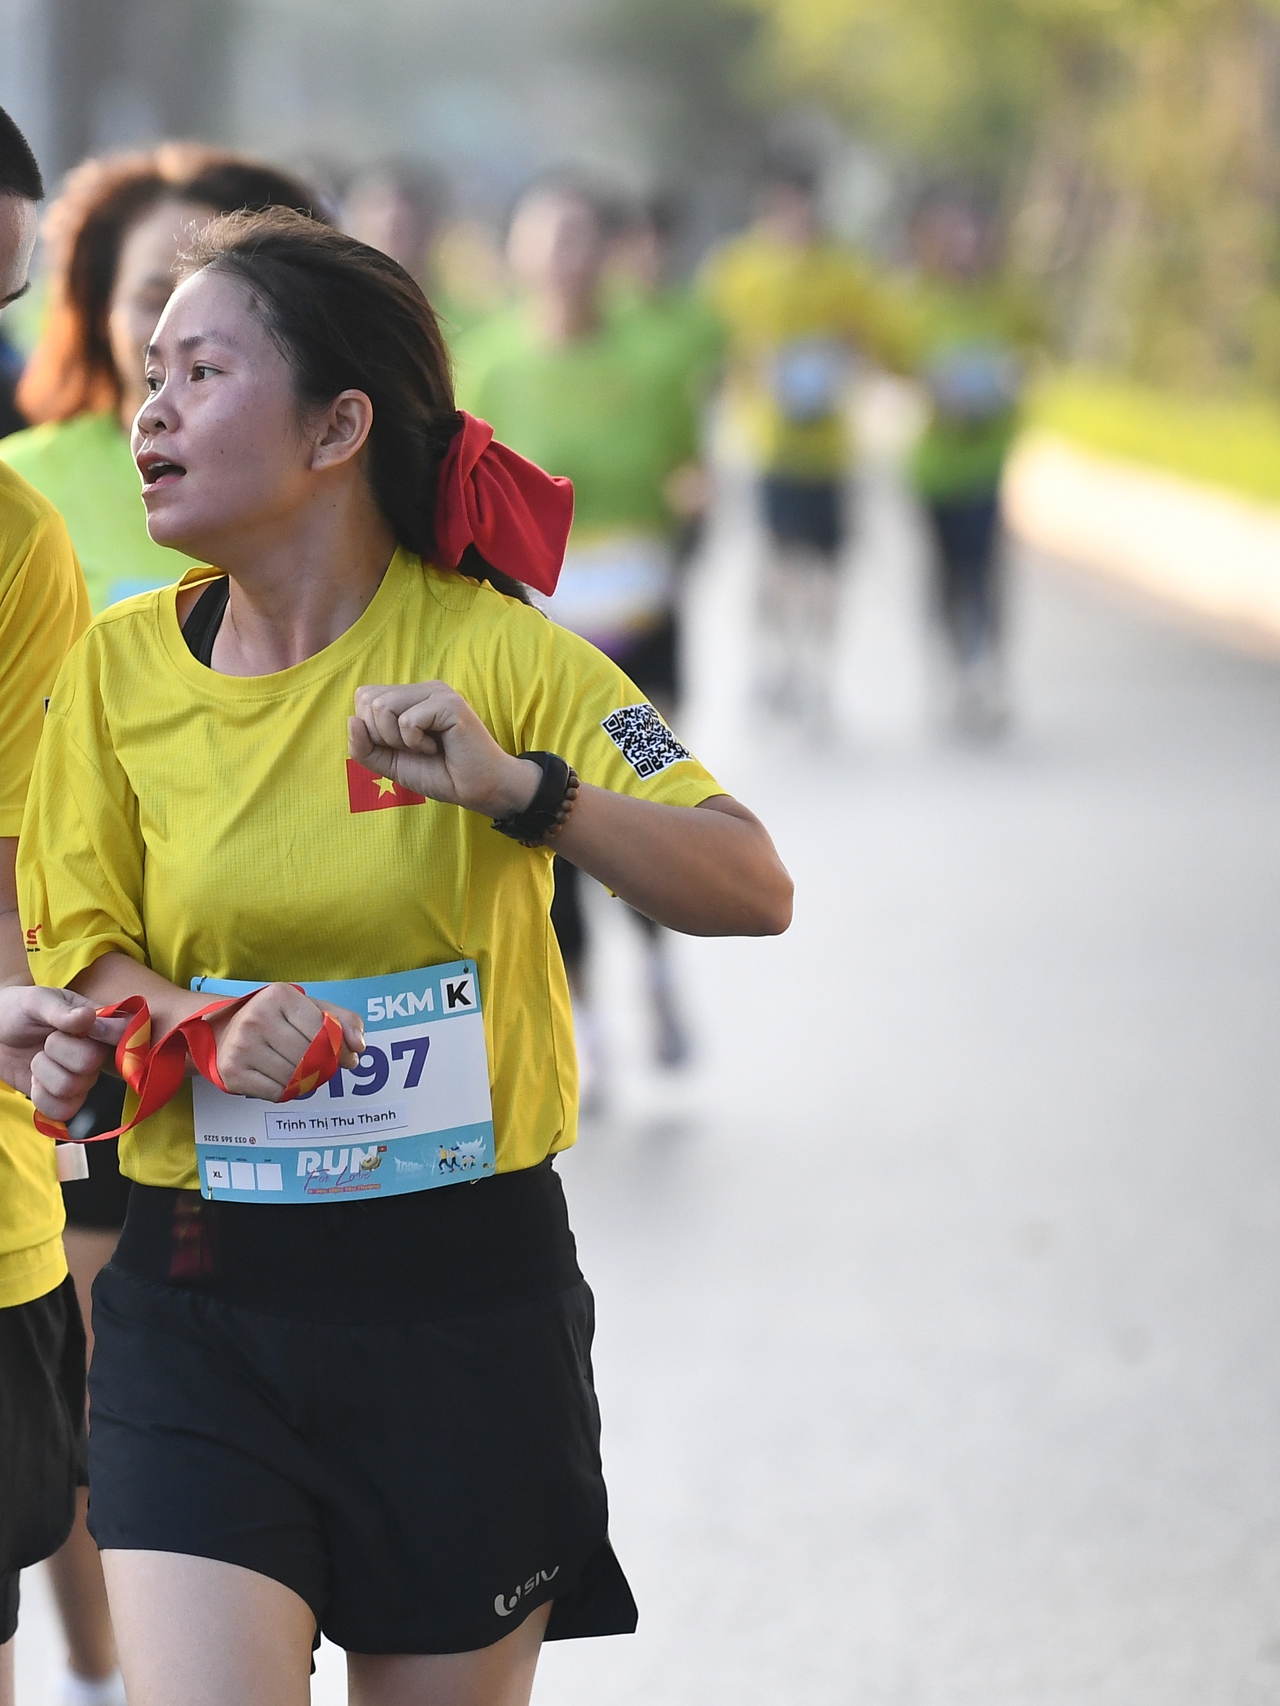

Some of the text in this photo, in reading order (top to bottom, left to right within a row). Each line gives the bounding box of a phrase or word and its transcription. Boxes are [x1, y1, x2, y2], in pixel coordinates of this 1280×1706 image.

[366, 988, 435, 1023] 5KM
[446, 980, 473, 1009] K
[276, 1110, 396, 1132] Trịnh Thị Thu Thanh
[213, 1170, 223, 1178] XL
[296, 1145, 378, 1177] RUN
